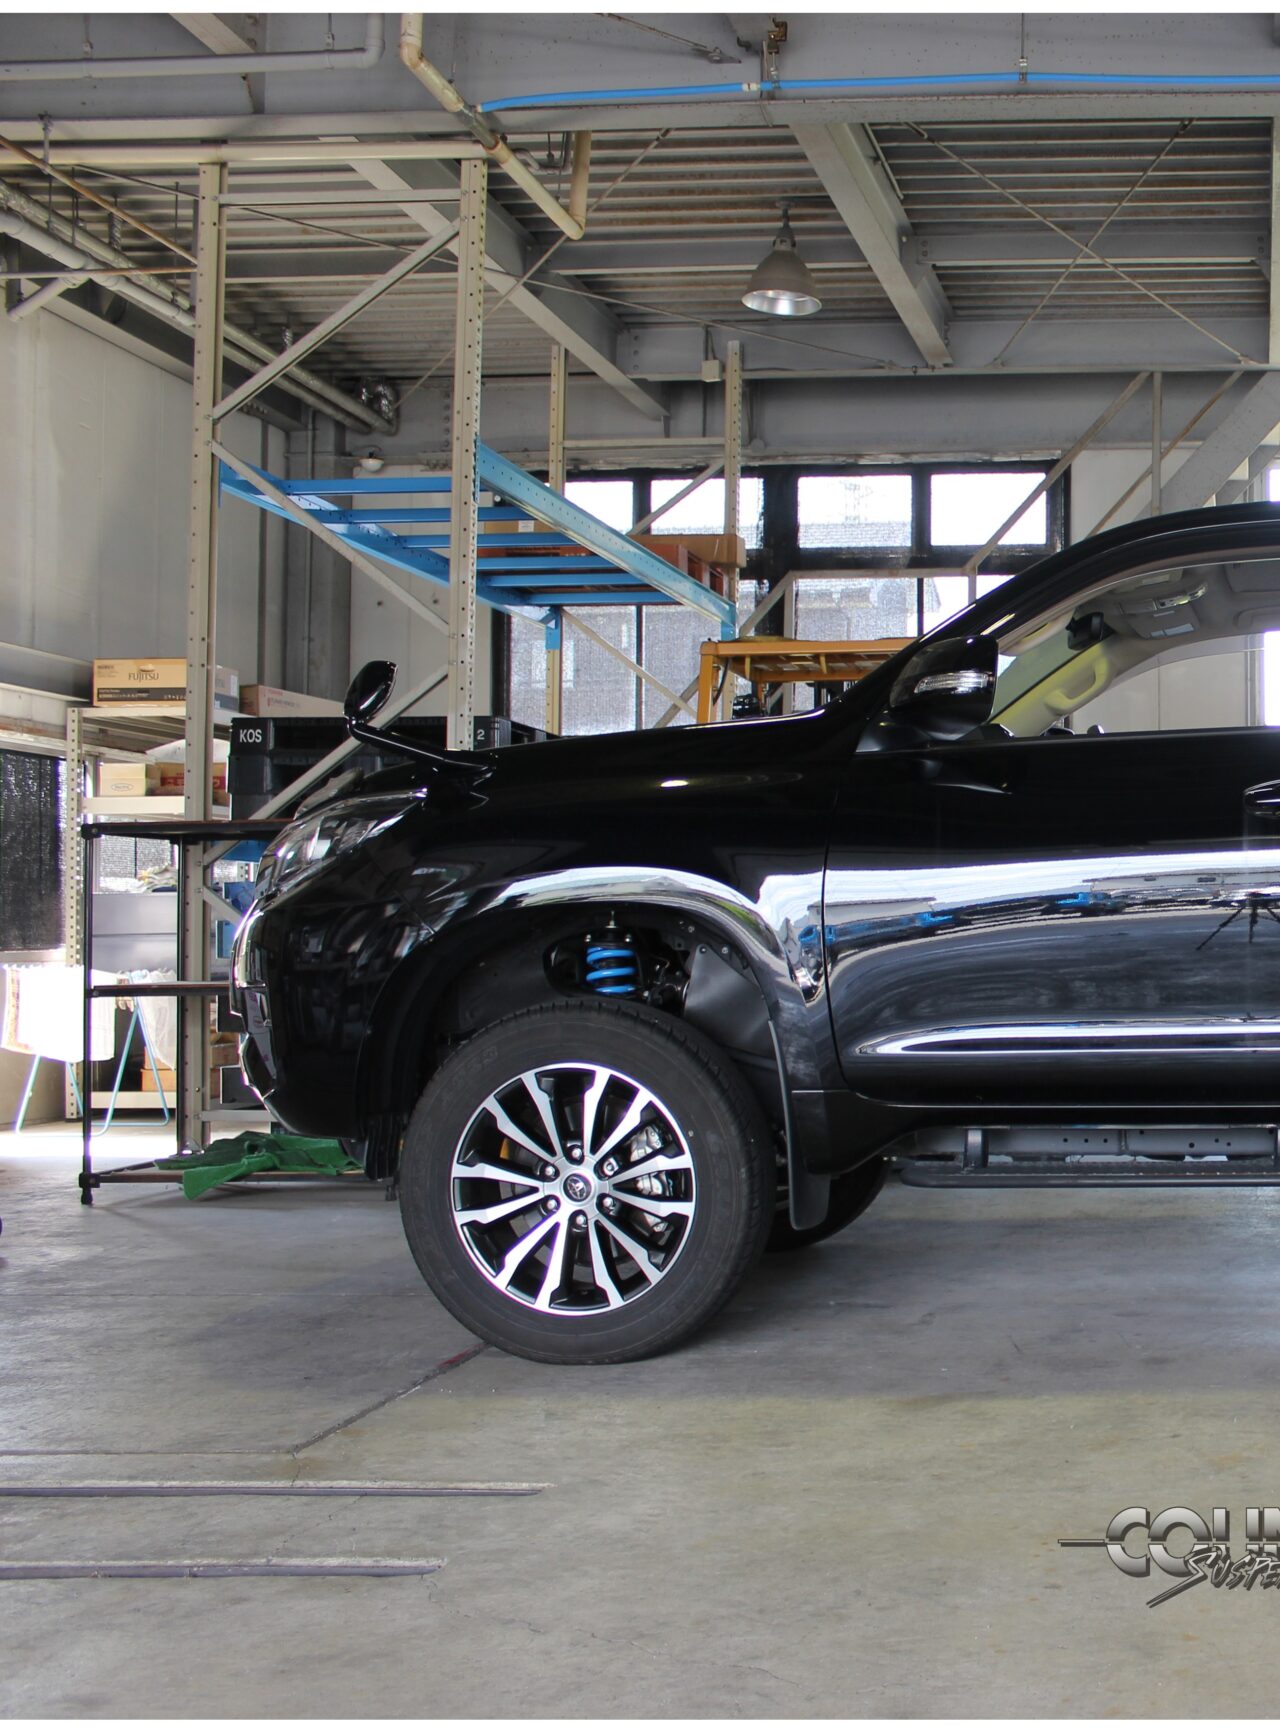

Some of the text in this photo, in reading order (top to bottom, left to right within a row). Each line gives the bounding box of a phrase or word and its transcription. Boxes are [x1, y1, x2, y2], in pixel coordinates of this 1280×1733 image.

[128, 672, 159, 682] FUJITSU
[239, 729, 262, 743] KOS
[477, 729, 485, 740] 2
